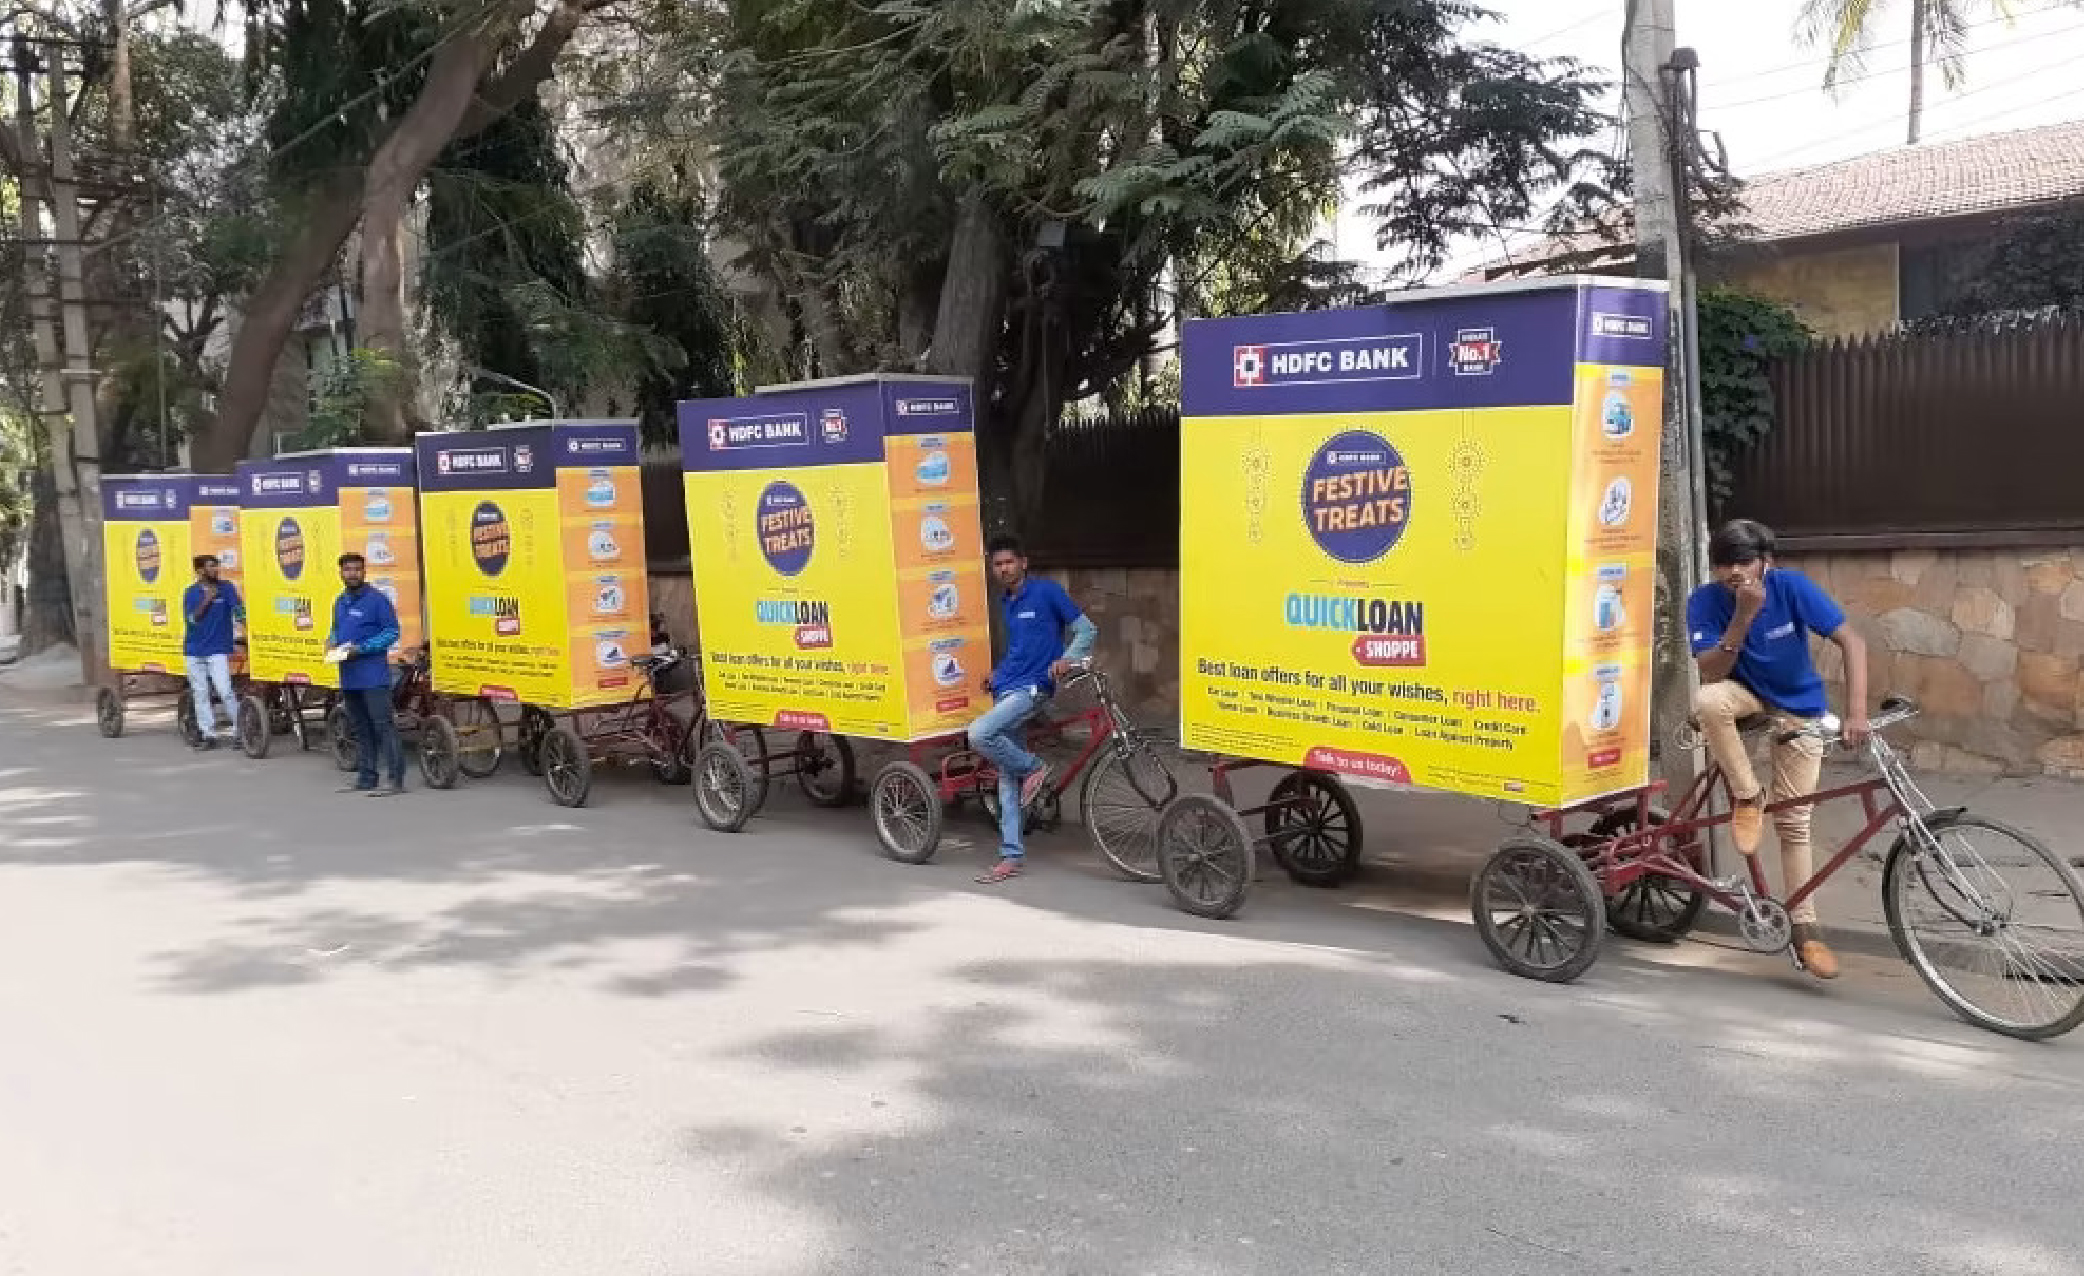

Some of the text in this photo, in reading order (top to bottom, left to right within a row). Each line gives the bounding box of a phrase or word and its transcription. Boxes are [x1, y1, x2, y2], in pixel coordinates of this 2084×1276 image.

[1272, 347, 1409, 375] HDFC BANK
[1459, 345, 1490, 362] No.1
[728, 421, 802, 442] HDFC BANK
[1313, 465, 1408, 503] FESTIVE
[762, 506, 812, 533] FESTIVE
[1313, 498, 1404, 532] TREATS
[764, 527, 811, 554] TREATS
[1286, 593, 1423, 635] QUICKLOAN
[1365, 640, 1418, 659] SHOPPE
[1197, 657, 1541, 713] Best loan offers for all your wishes, right here.
